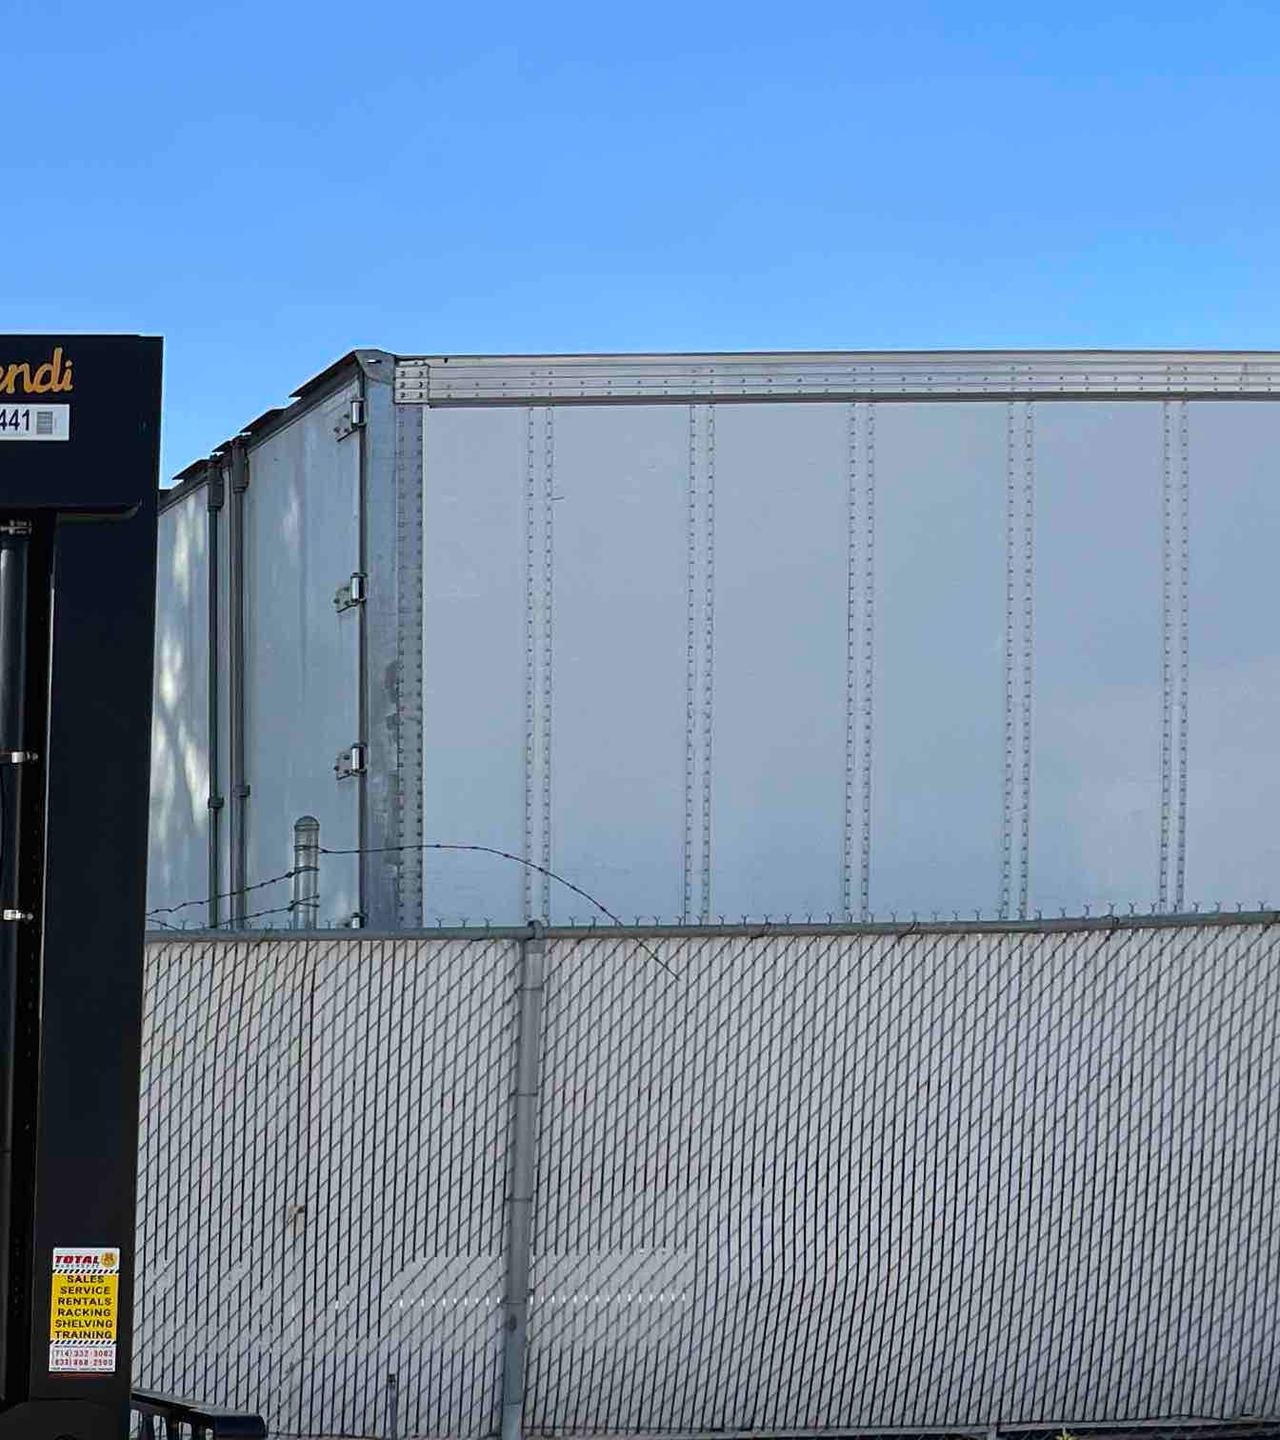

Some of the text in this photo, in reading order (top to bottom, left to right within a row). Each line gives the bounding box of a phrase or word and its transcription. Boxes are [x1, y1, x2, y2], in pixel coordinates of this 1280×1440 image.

[55, 1255, 99, 1264] TOTAL
[67, 1275, 105, 1283] SALES
[60, 1286, 111, 1294] SERVICE
[58, 1297, 112, 1306] RENTALS
[57, 1308, 111, 1317] RACKING
[55, 1319, 113, 1328] SHELVING
[55, 1330, 112, 1339] TRAINING
